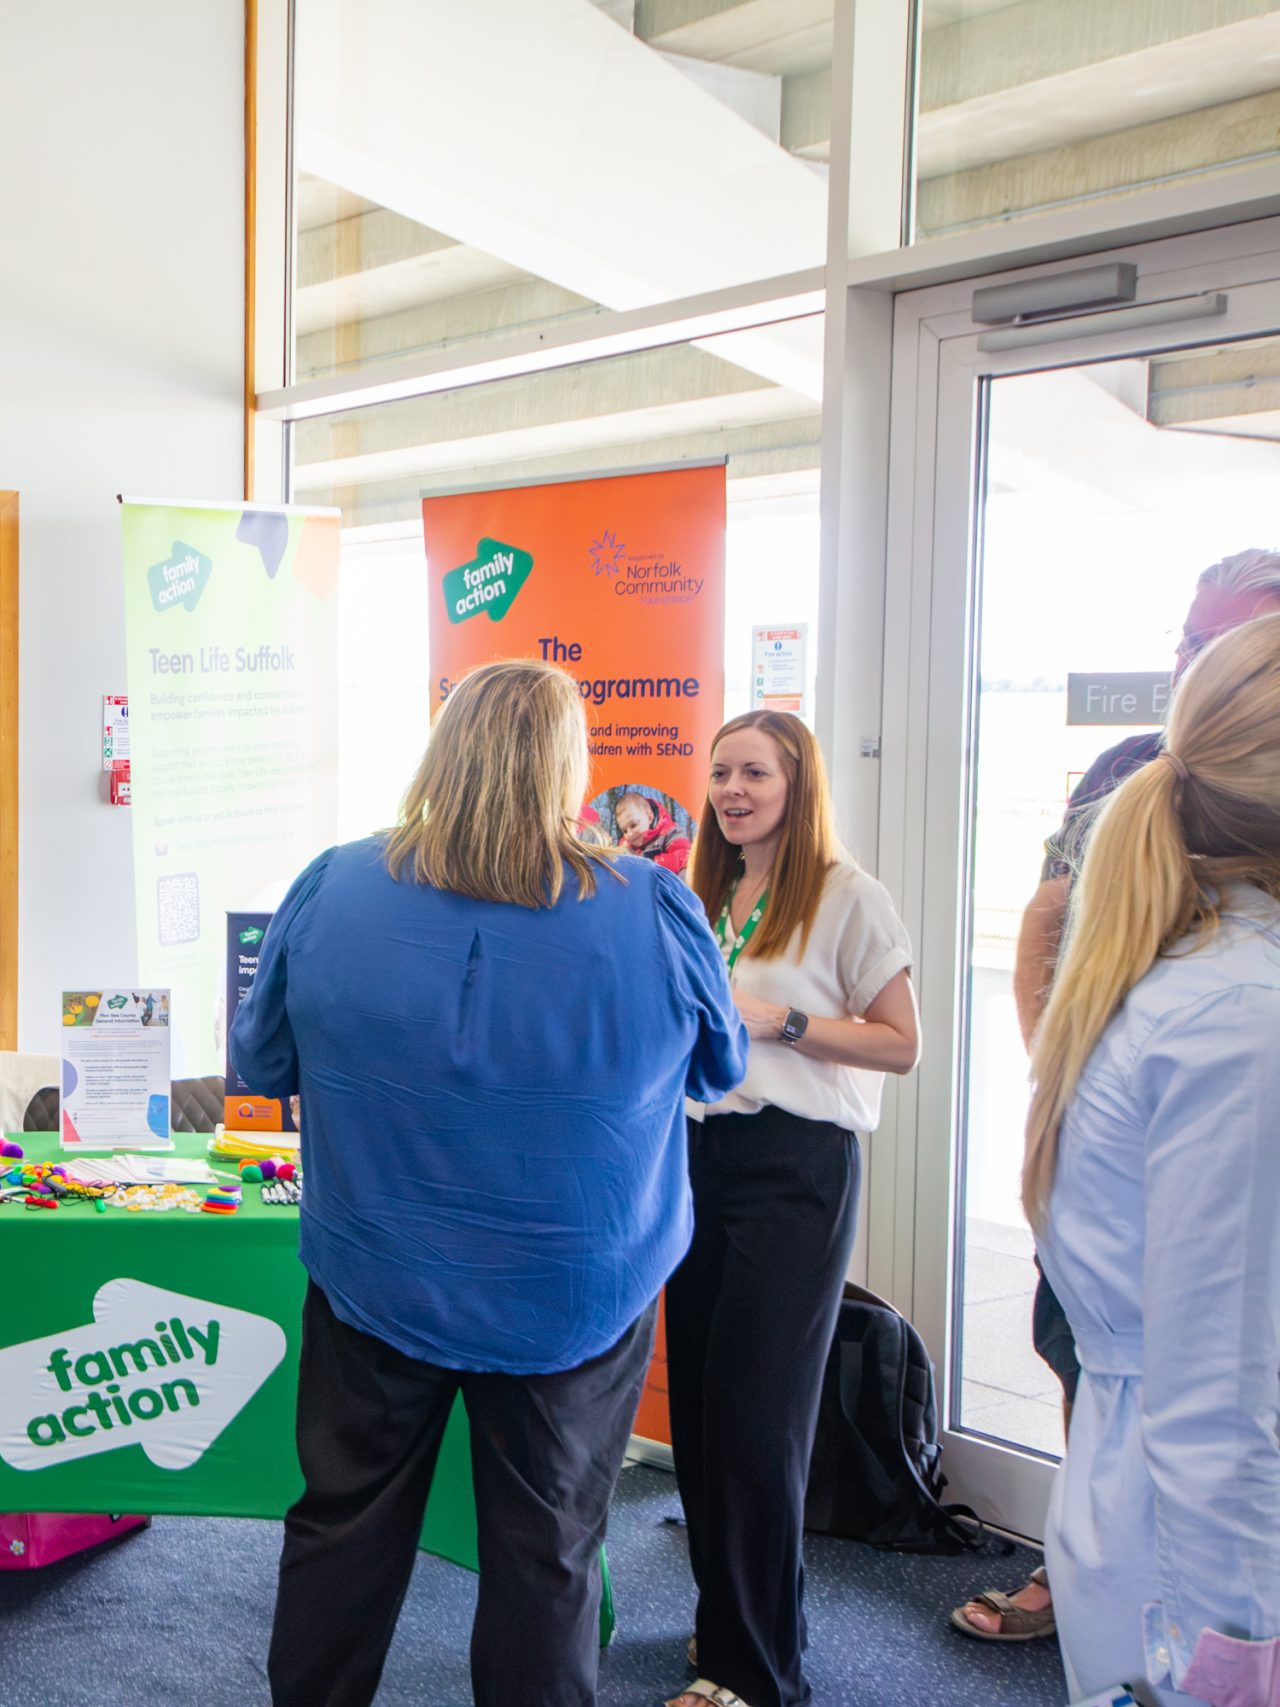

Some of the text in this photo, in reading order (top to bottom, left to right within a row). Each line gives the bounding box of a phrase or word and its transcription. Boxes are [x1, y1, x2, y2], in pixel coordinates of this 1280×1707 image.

[163, 555, 200, 583] family
[463, 551, 514, 589] family
[627, 562, 681, 579] Norfolk
[158, 577, 196, 604] action
[456, 578, 506, 616] action
[615, 577, 704, 596] Community
[149, 645, 295, 674] Teen Life Suffolk
[538, 636, 583, 662] The
[150, 693, 185, 706] Building
[236, 690, 252, 701] and
[577, 677, 700, 706] ogramme
[1086, 684, 1138, 714] Fire
[150, 709, 192, 722] empower
[590, 723, 679, 740] and improving
[588, 742, 694, 757] ildren with SEND
[238, 955, 259, 964] Teen
[47, 1317, 220, 1392] family
[26, 1378, 200, 1447] action
